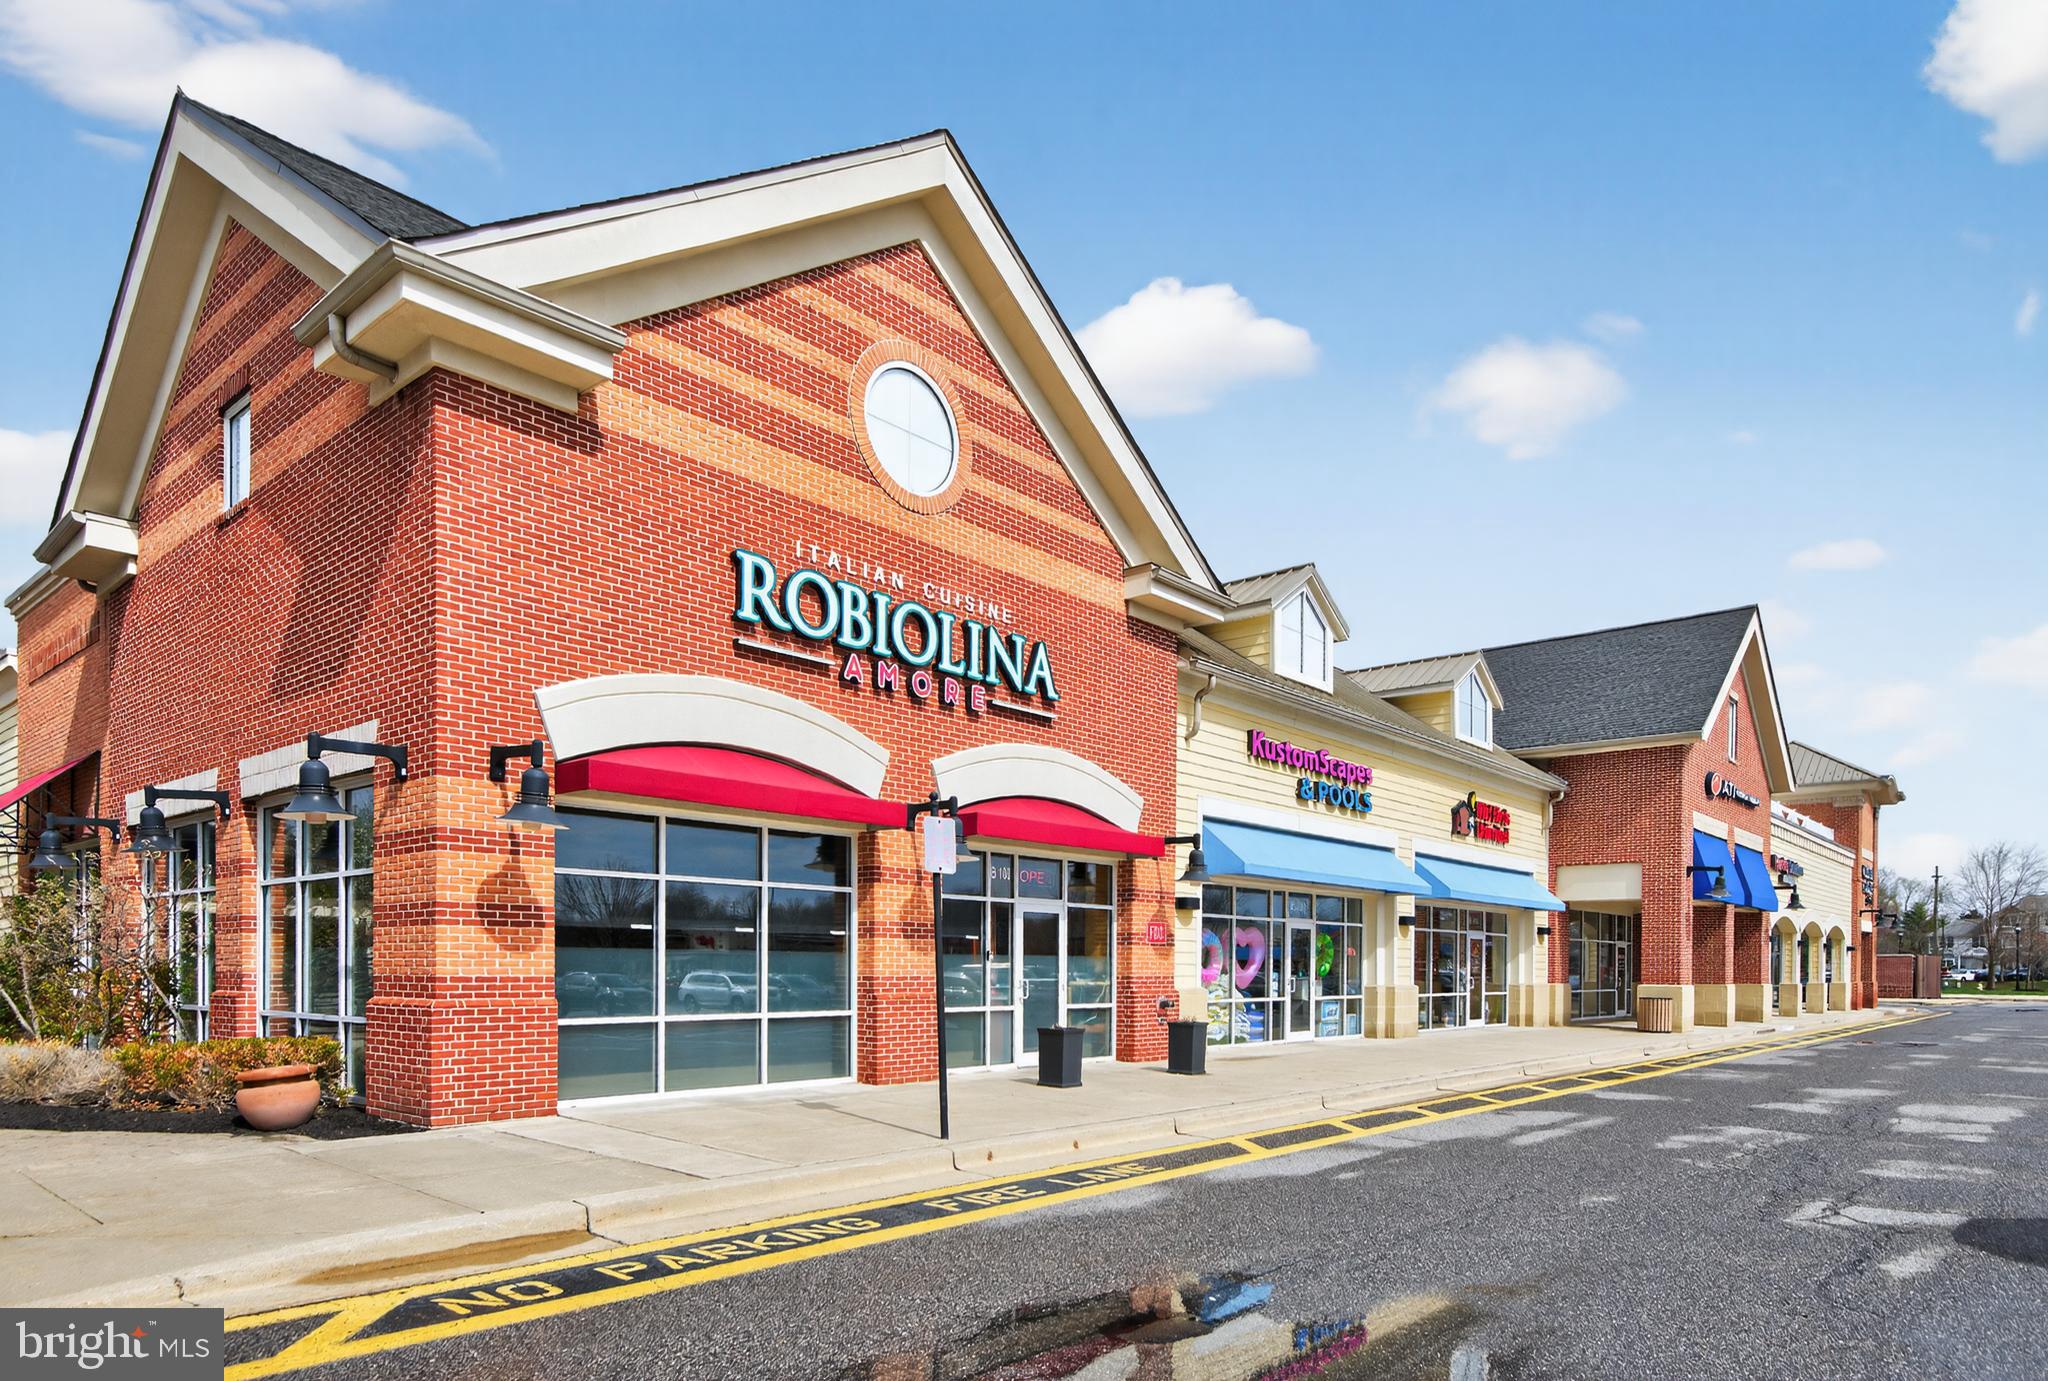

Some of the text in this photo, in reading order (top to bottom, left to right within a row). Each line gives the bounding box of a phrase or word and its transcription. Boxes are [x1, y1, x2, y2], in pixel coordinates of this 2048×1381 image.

[795, 540, 1014, 624] ITALIAN CUISINE
[733, 548, 1061, 700] ROBIOLINA
[843, 653, 987, 716] AMORE
[1249, 728, 1373, 785] KustomScapes
[1299, 776, 1373, 813] & POOLS
[1019, 869, 1054, 886] OPE
[431, 1162, 1166, 1316] NO PARKING FIRE LANE
